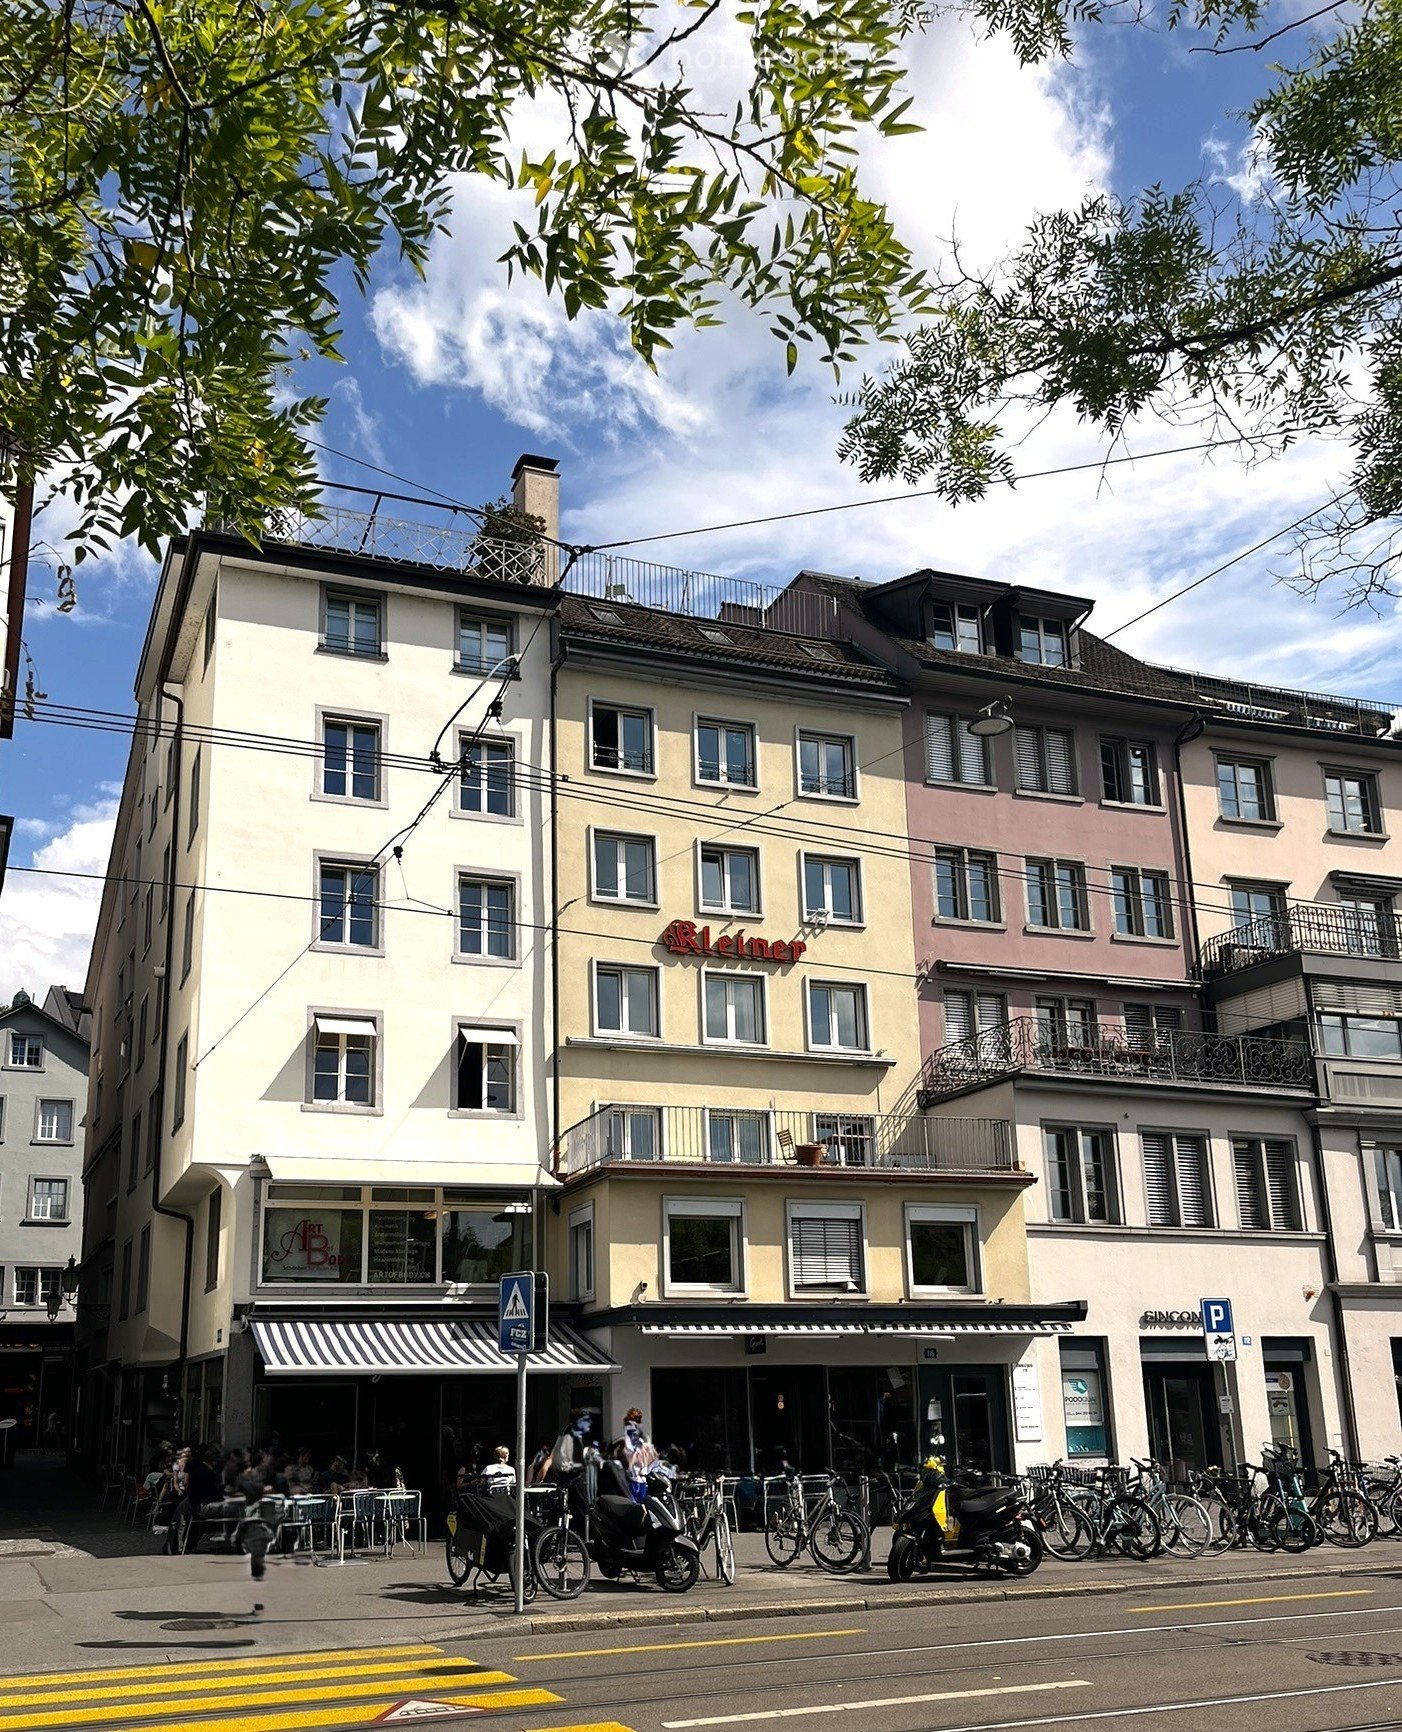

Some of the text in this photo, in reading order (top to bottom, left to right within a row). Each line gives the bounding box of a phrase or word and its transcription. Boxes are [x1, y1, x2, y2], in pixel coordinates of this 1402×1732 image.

[663, 919, 807, 962] Kleiner
[1210, 1305, 1225, 1330] P
[510, 1327, 528, 1339] FCZ
